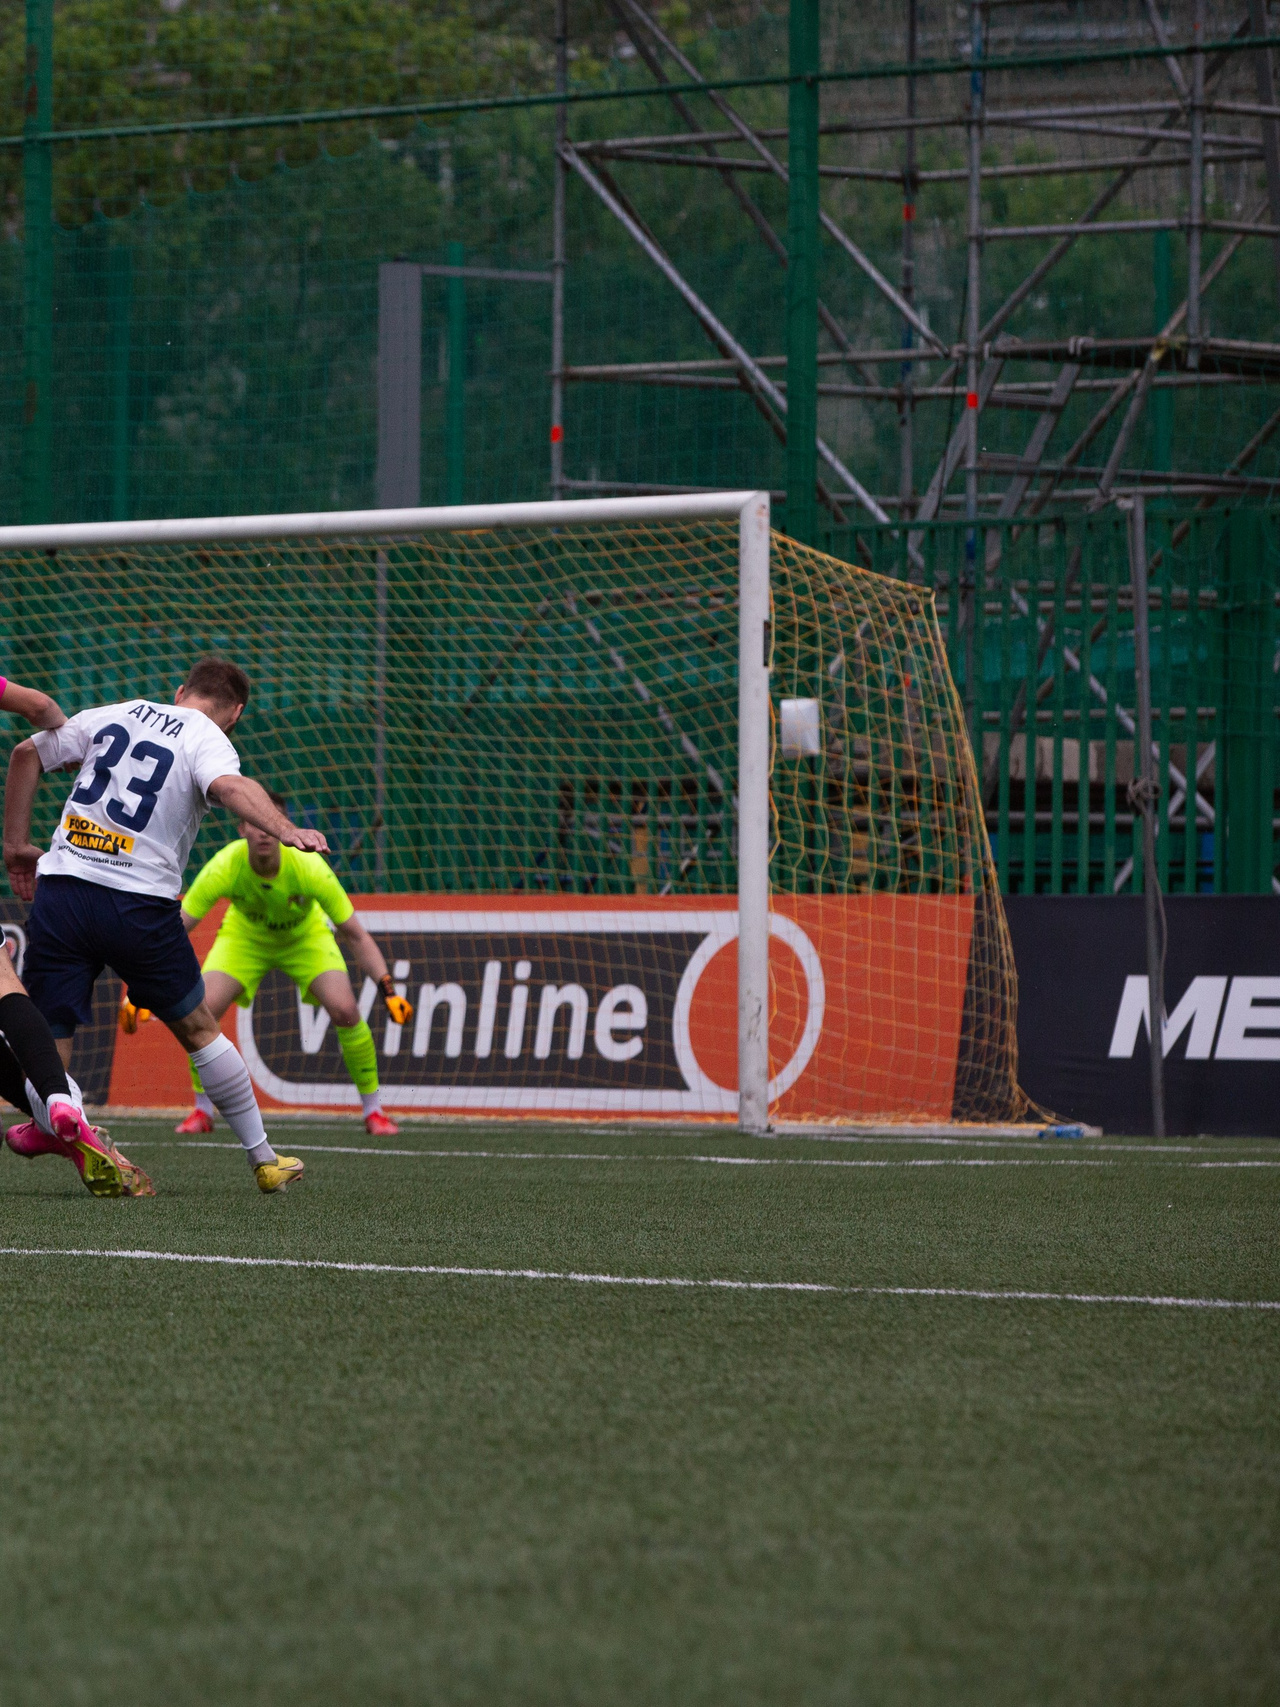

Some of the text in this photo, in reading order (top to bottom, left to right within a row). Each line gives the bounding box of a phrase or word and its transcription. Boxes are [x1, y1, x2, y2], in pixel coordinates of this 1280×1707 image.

[128, 703, 184, 739] ATTYA
[71, 723, 175, 833] 33
[70, 833, 114, 853] MANIA
[296, 959, 648, 1062] Winline
